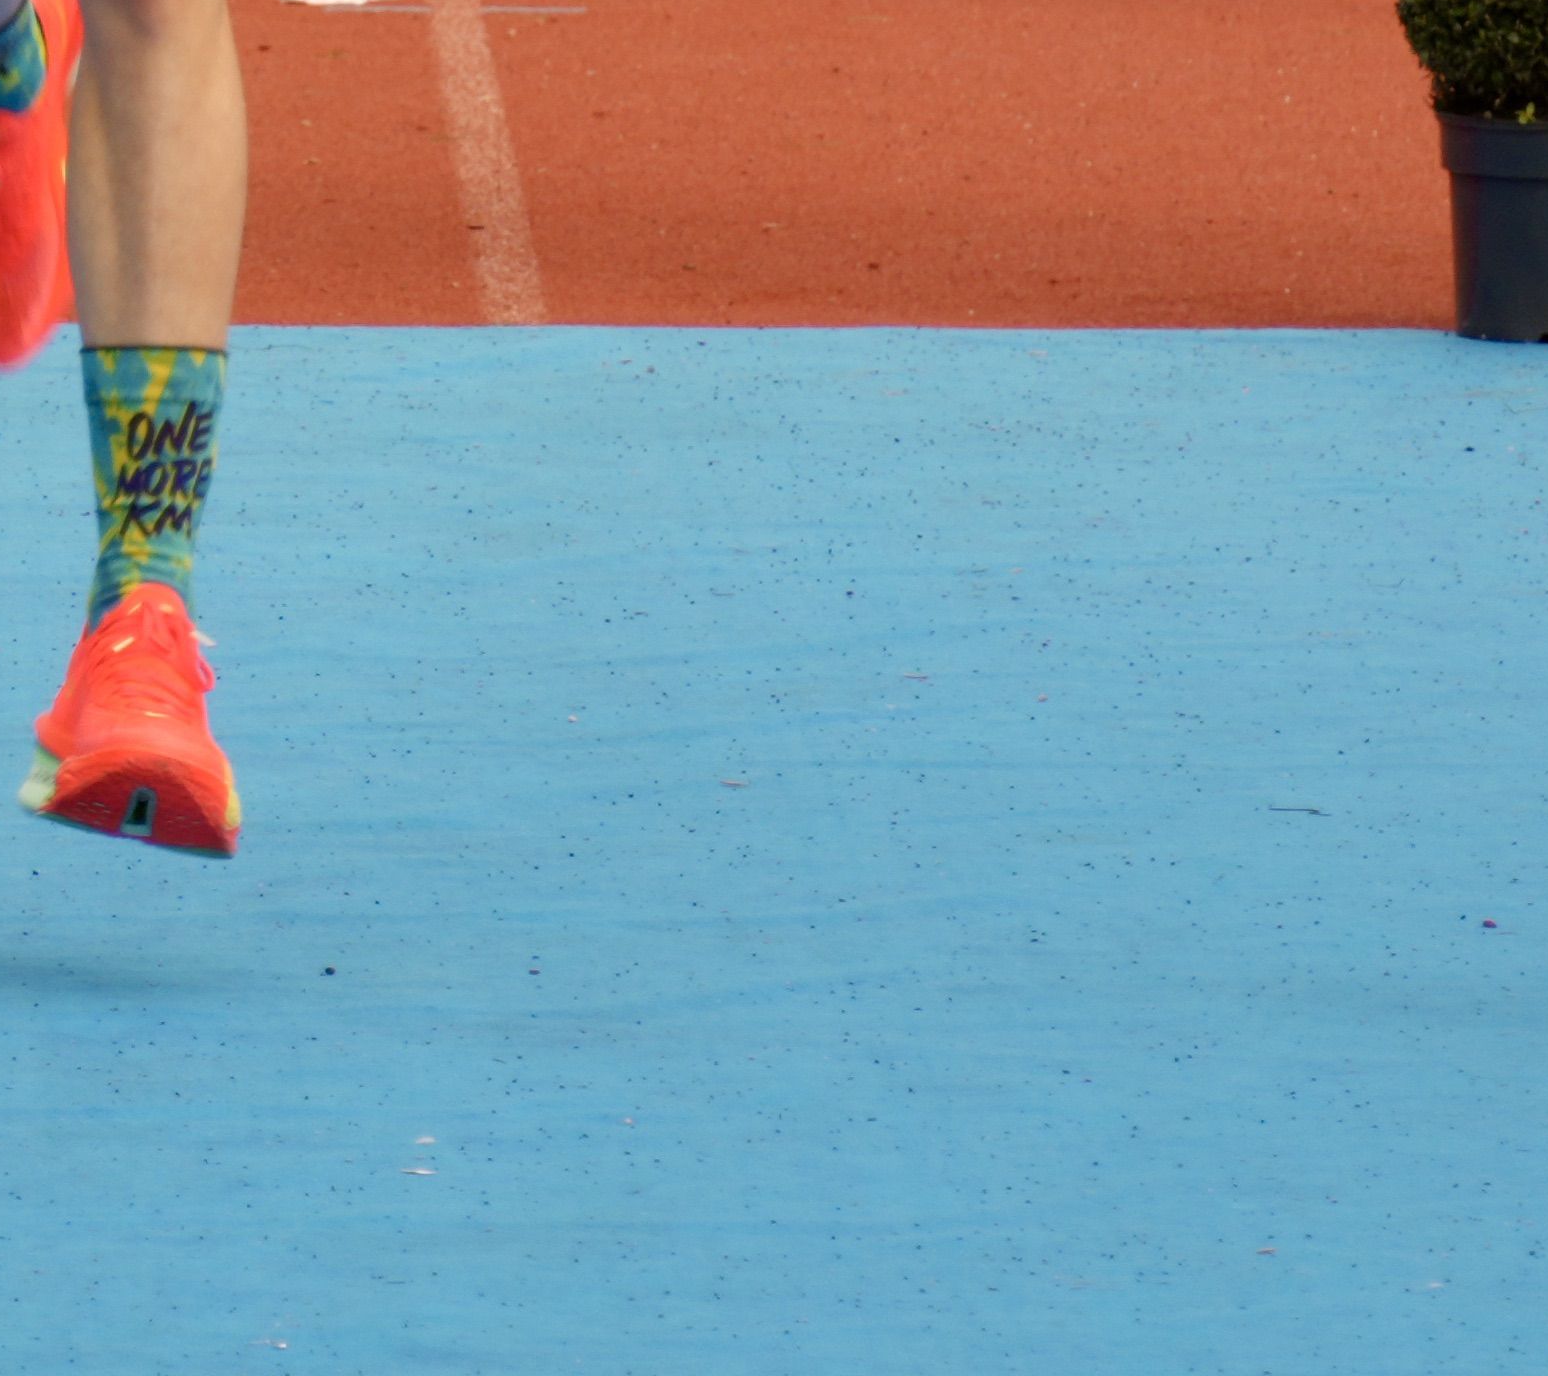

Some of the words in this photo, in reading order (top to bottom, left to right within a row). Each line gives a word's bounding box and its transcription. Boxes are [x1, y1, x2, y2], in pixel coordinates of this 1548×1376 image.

[127, 401, 215, 461] ONE
[110, 456, 213, 505] MORE
[119, 498, 194, 540] KM
